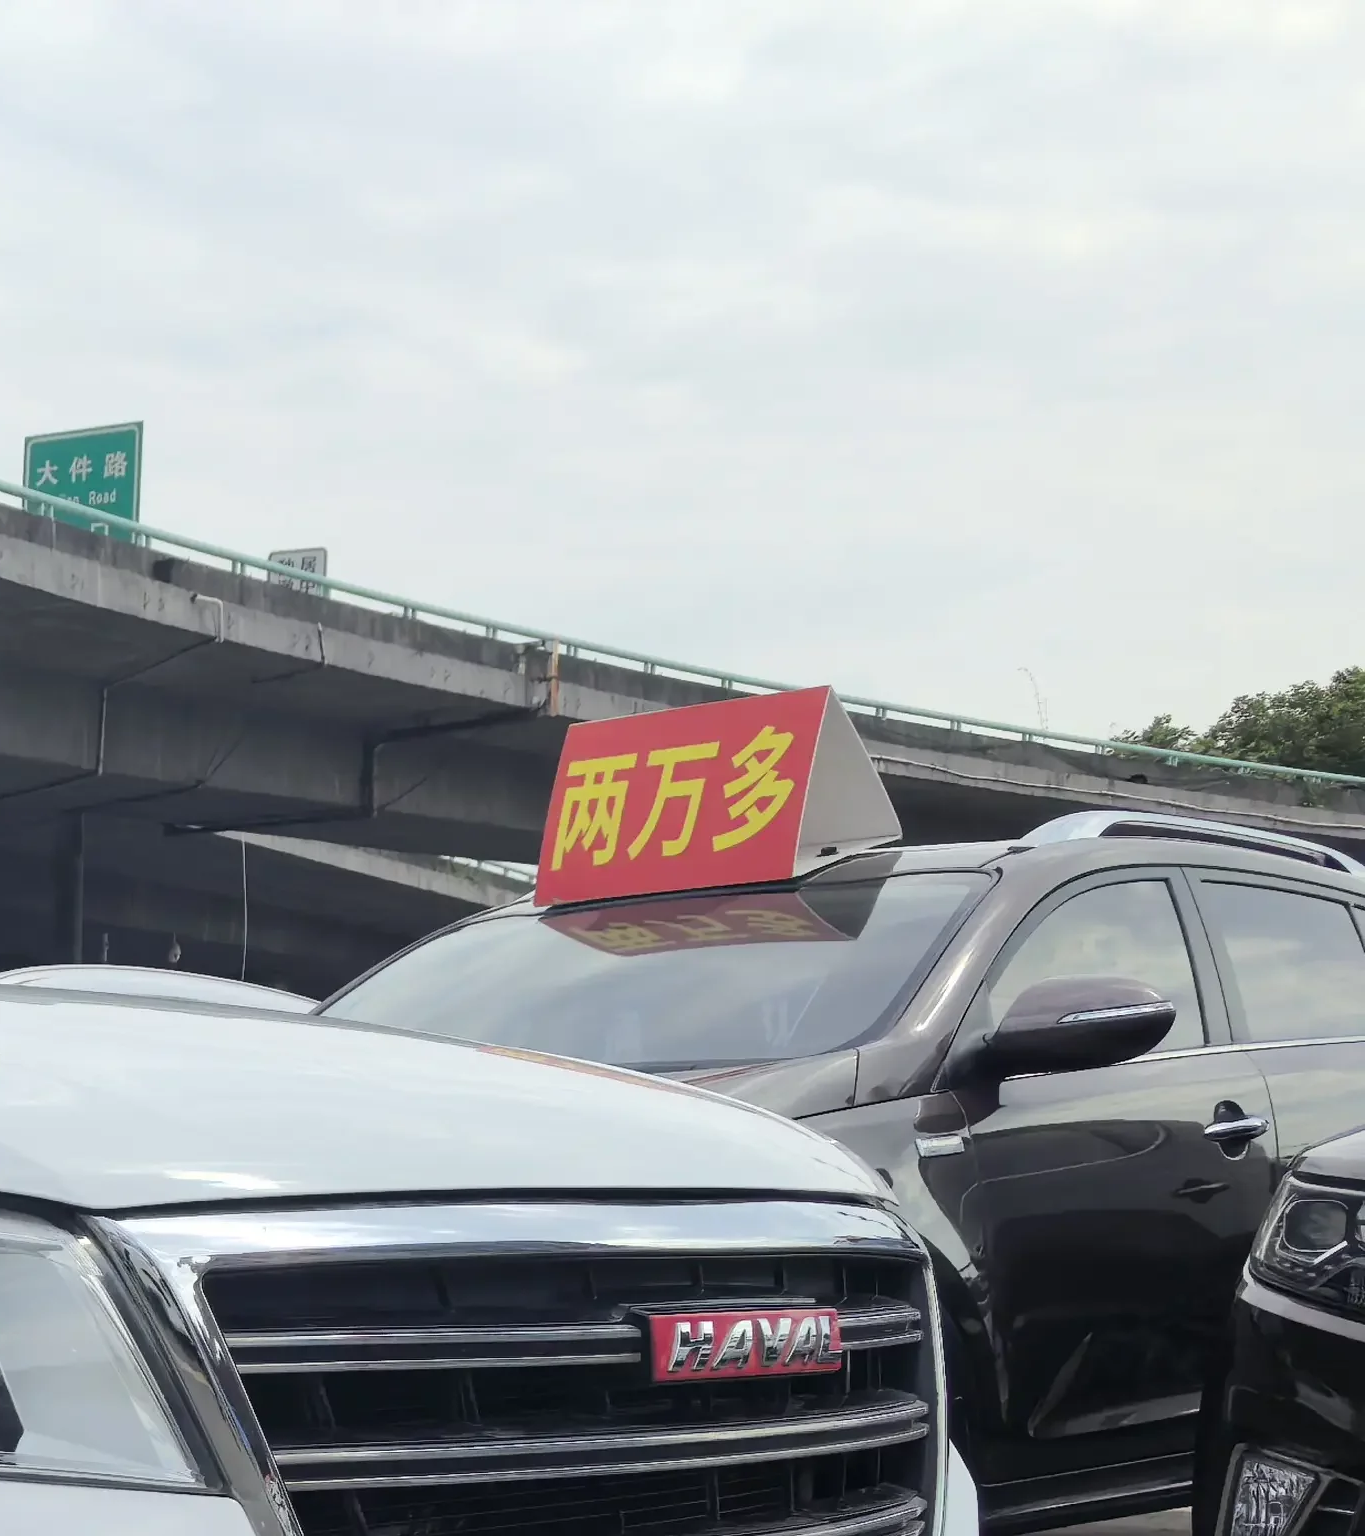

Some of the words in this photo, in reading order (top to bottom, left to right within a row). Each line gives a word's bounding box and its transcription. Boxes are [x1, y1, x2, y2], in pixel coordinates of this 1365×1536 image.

[36, 451, 128, 486] 大件路
[88, 488, 117, 506] Road
[550, 725, 795, 871] 两万多
[667, 1315, 843, 1373] HAVAL
